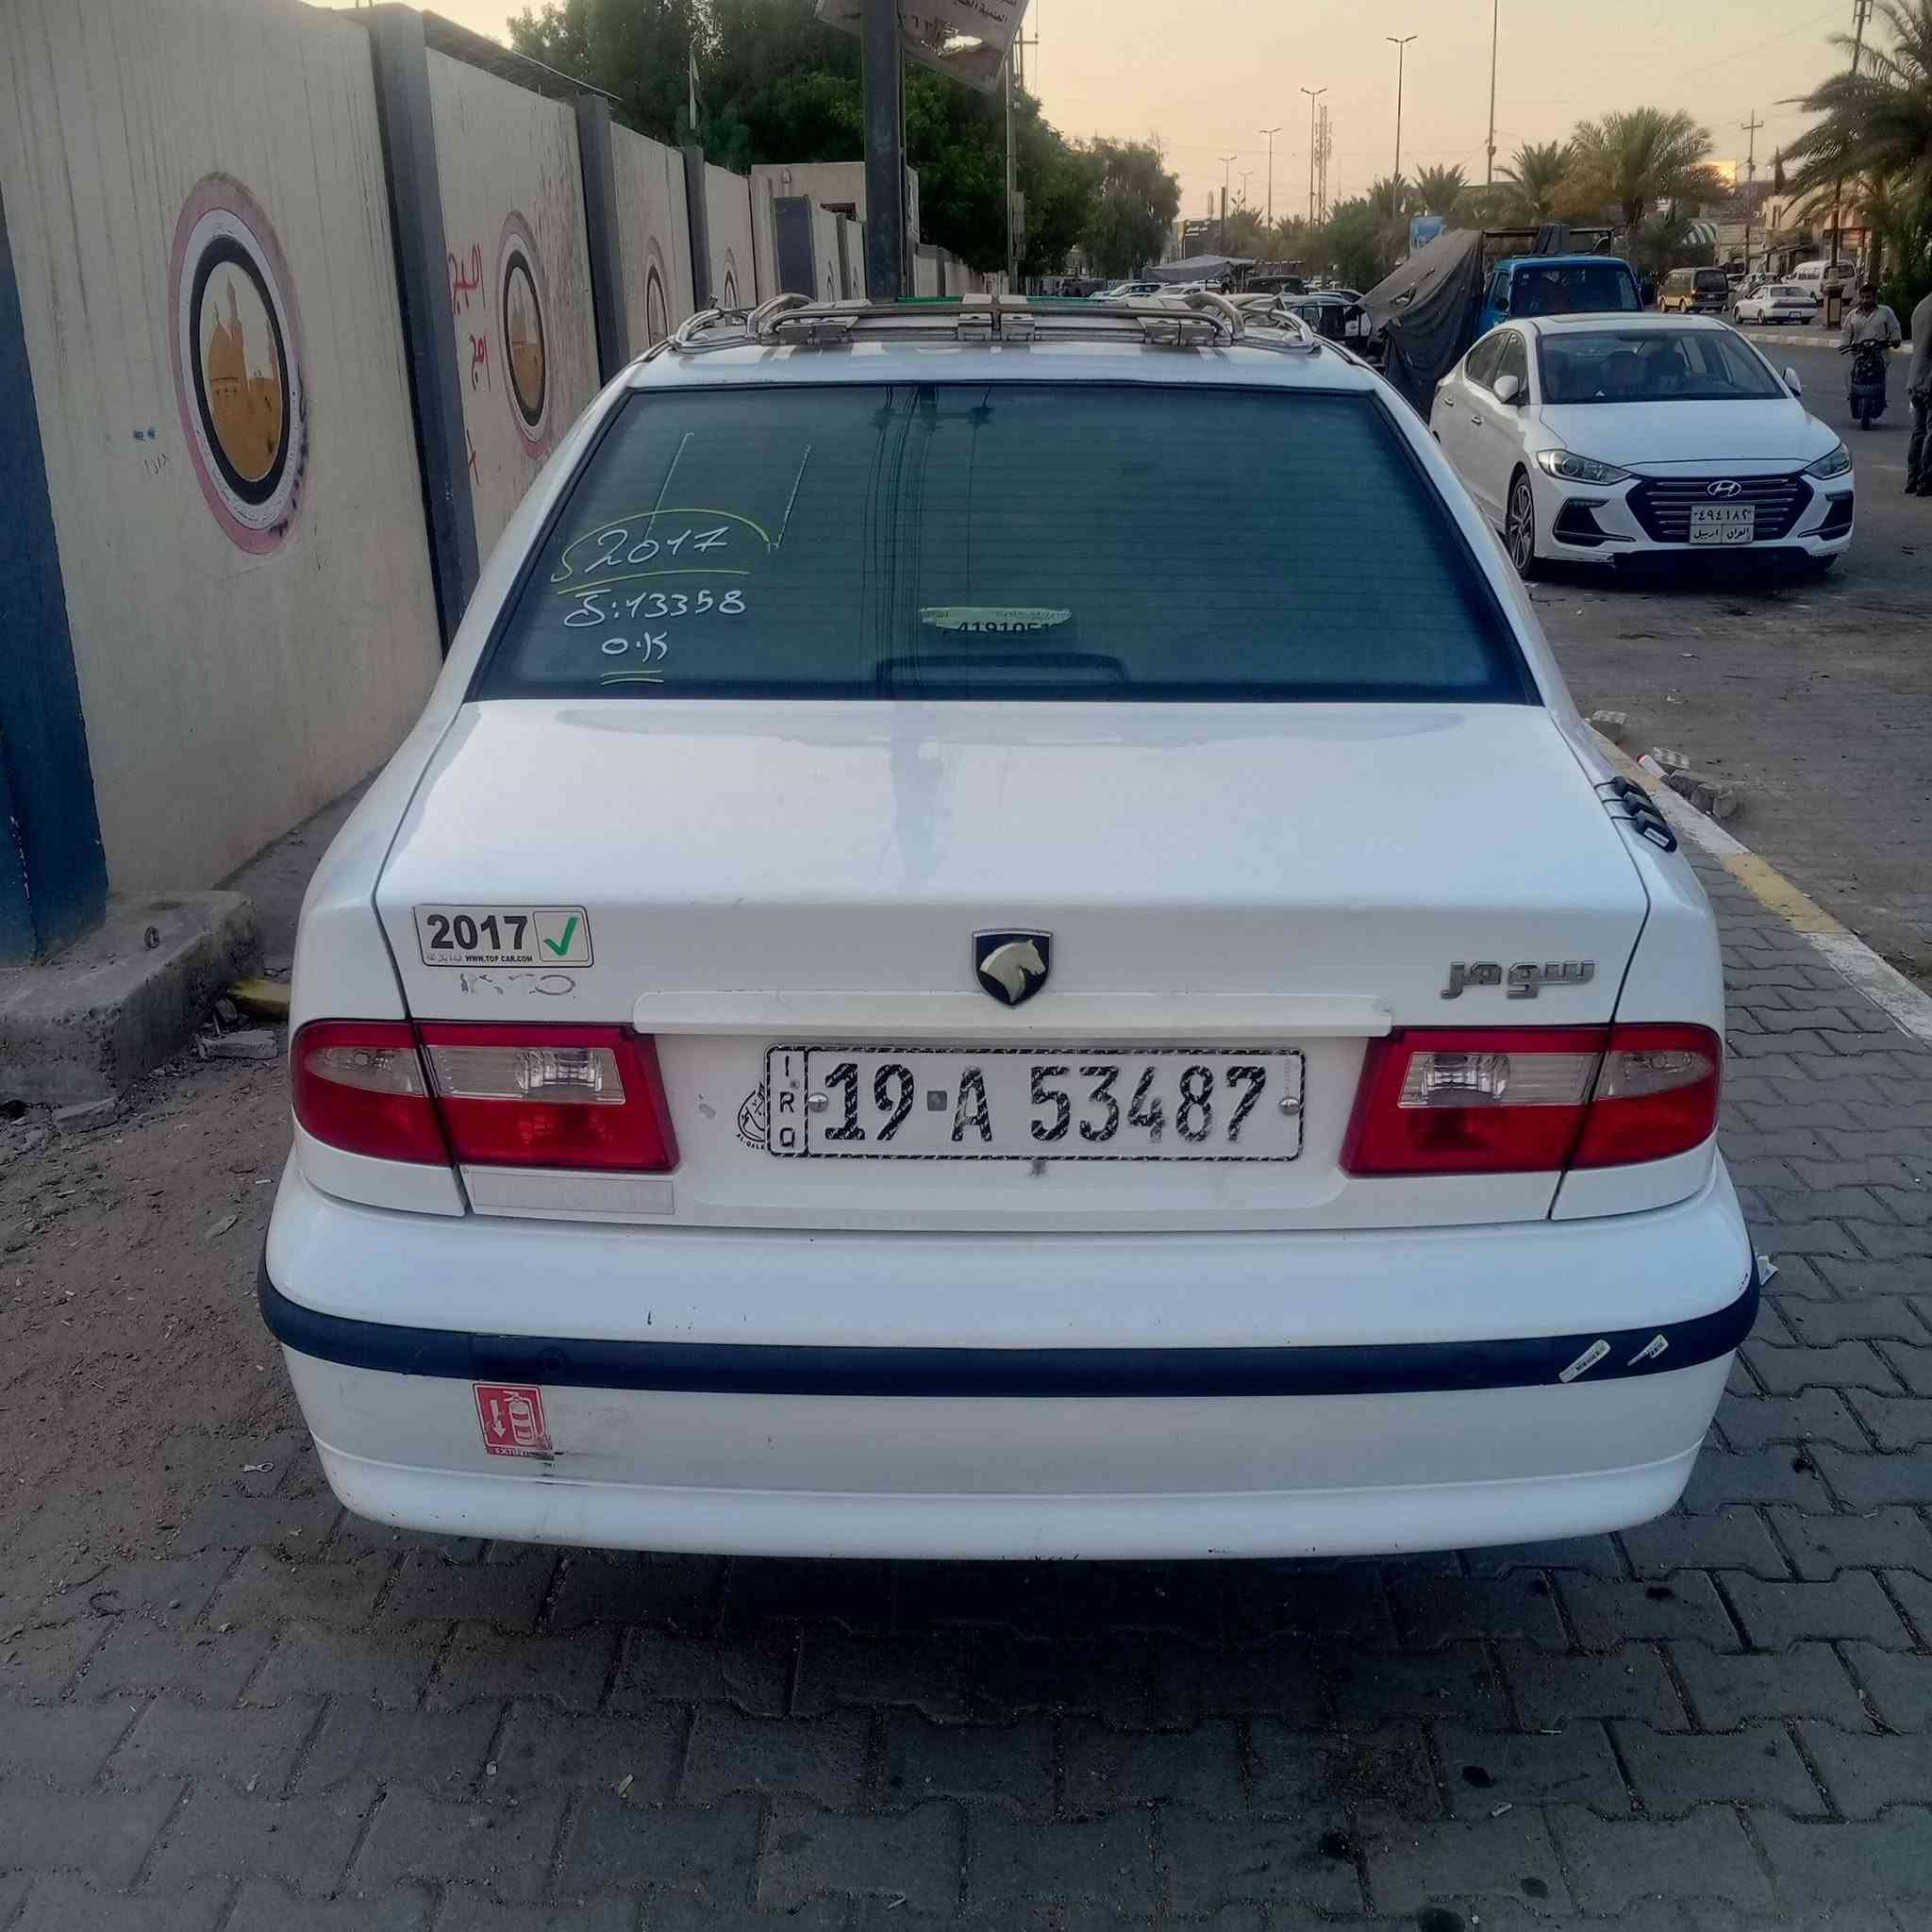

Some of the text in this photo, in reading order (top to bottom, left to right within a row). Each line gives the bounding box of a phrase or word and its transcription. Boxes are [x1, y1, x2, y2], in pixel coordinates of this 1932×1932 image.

[584, 525, 730, 573] 2017
[426, 913, 528, 951] 2017
[824, 1062, 914, 1141] 19
[951, 1065, 992, 1141] A
[1031, 1065, 1266, 1142] 53487
